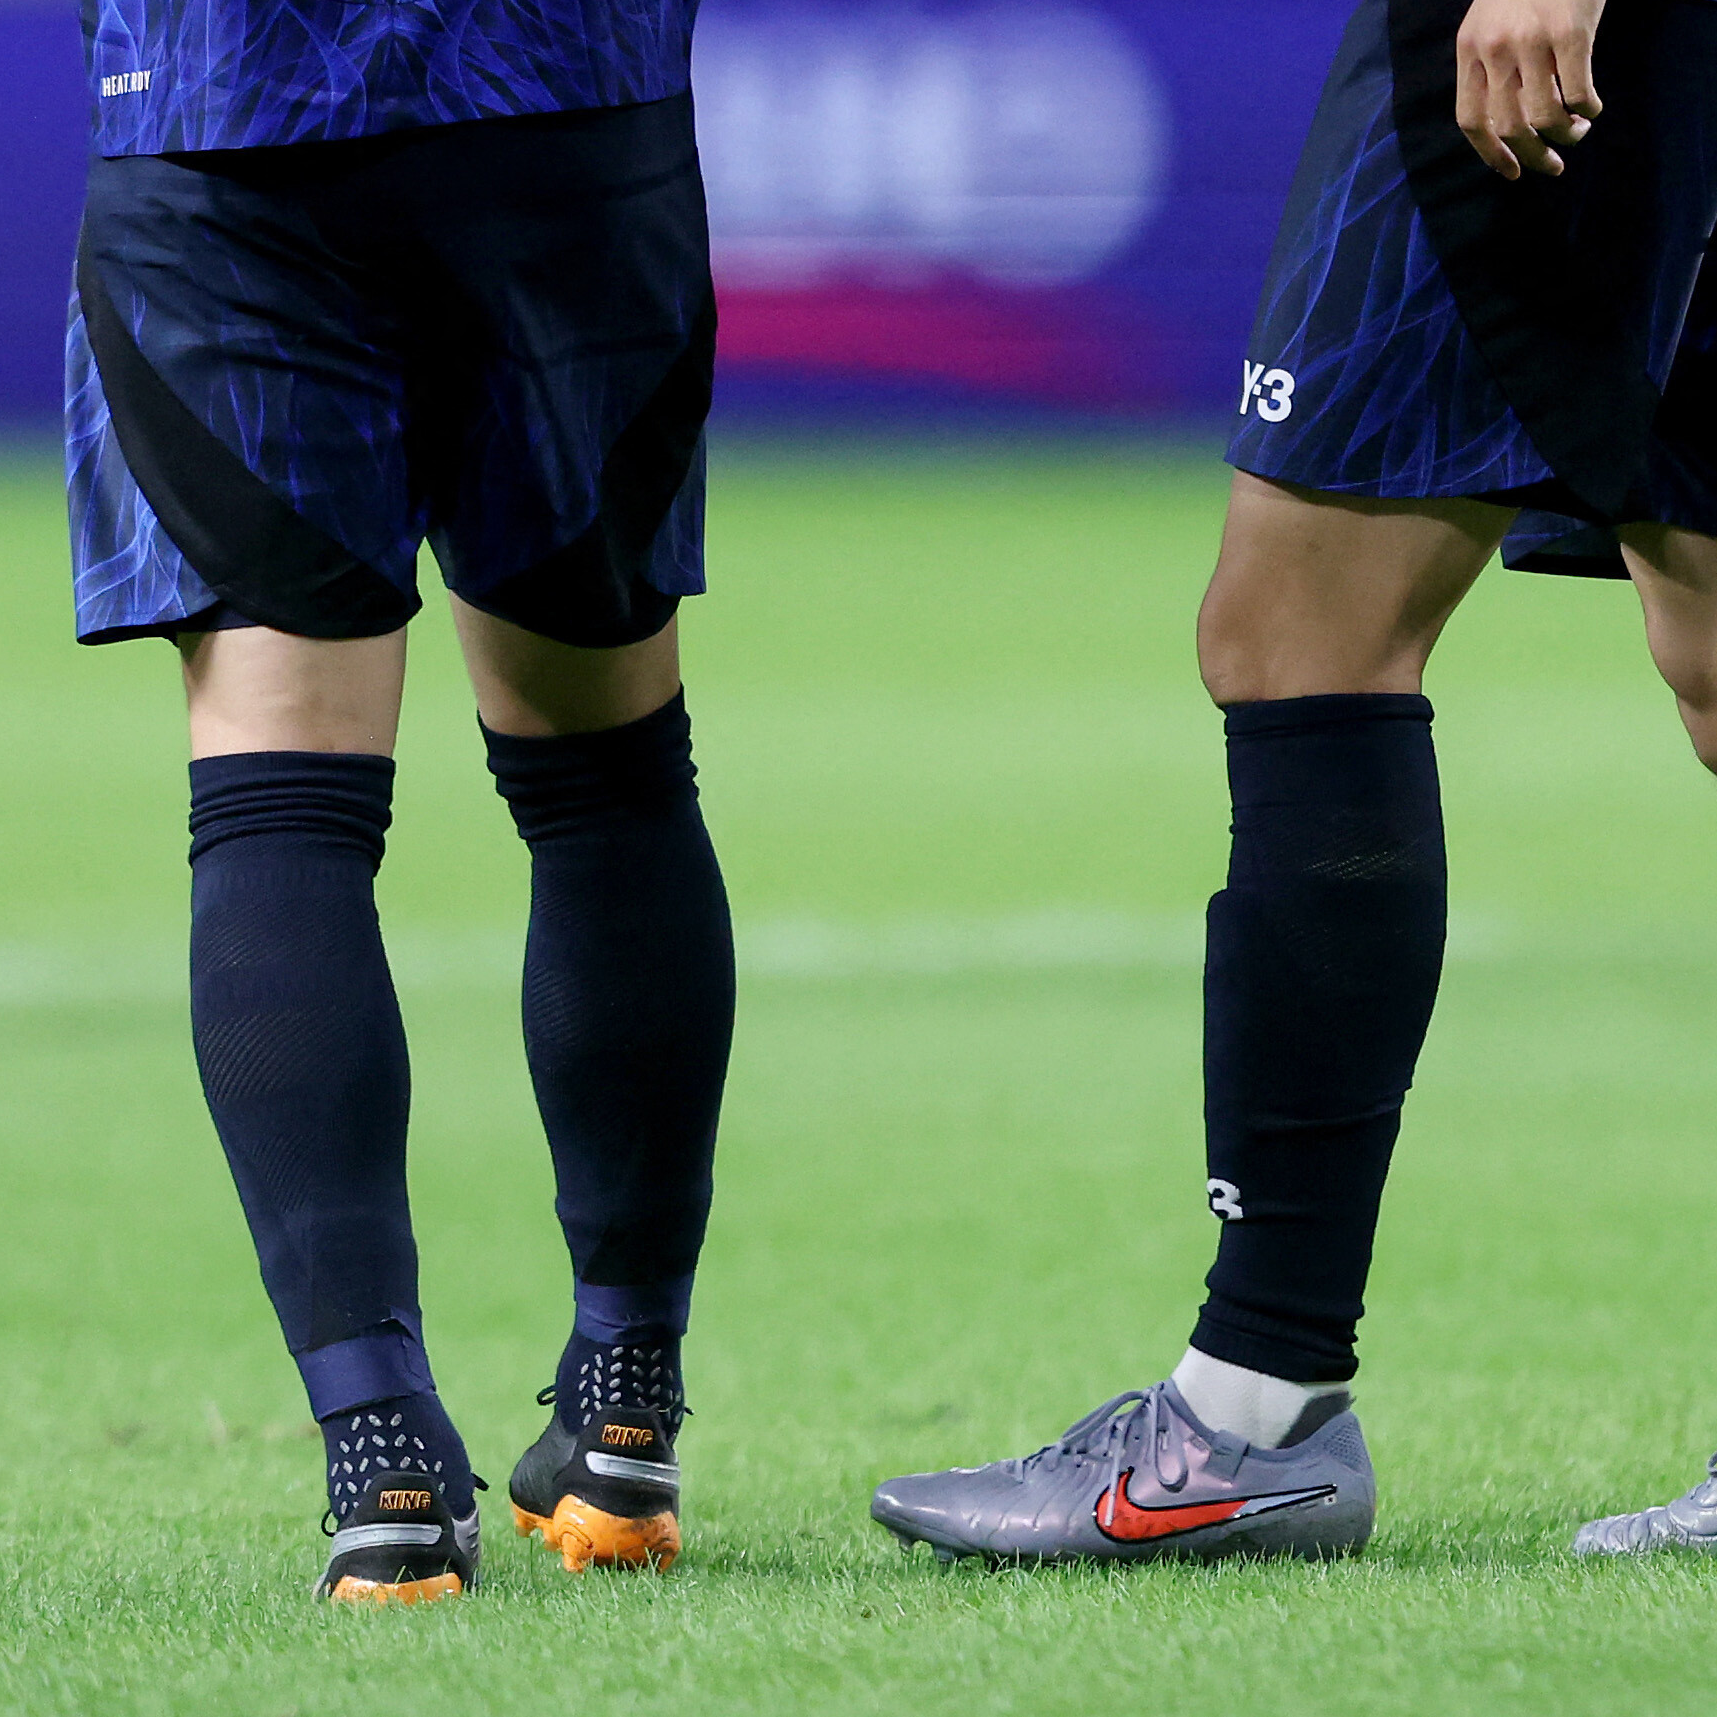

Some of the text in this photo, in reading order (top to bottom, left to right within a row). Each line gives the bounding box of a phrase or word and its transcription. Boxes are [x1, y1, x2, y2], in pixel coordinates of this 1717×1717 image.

[101, 70, 151, 98] HEAT.RDY
[1239, 359, 1296, 423] Y-3
[602, 1424, 654, 1446] KING
[379, 1490, 432, 1510] KING
